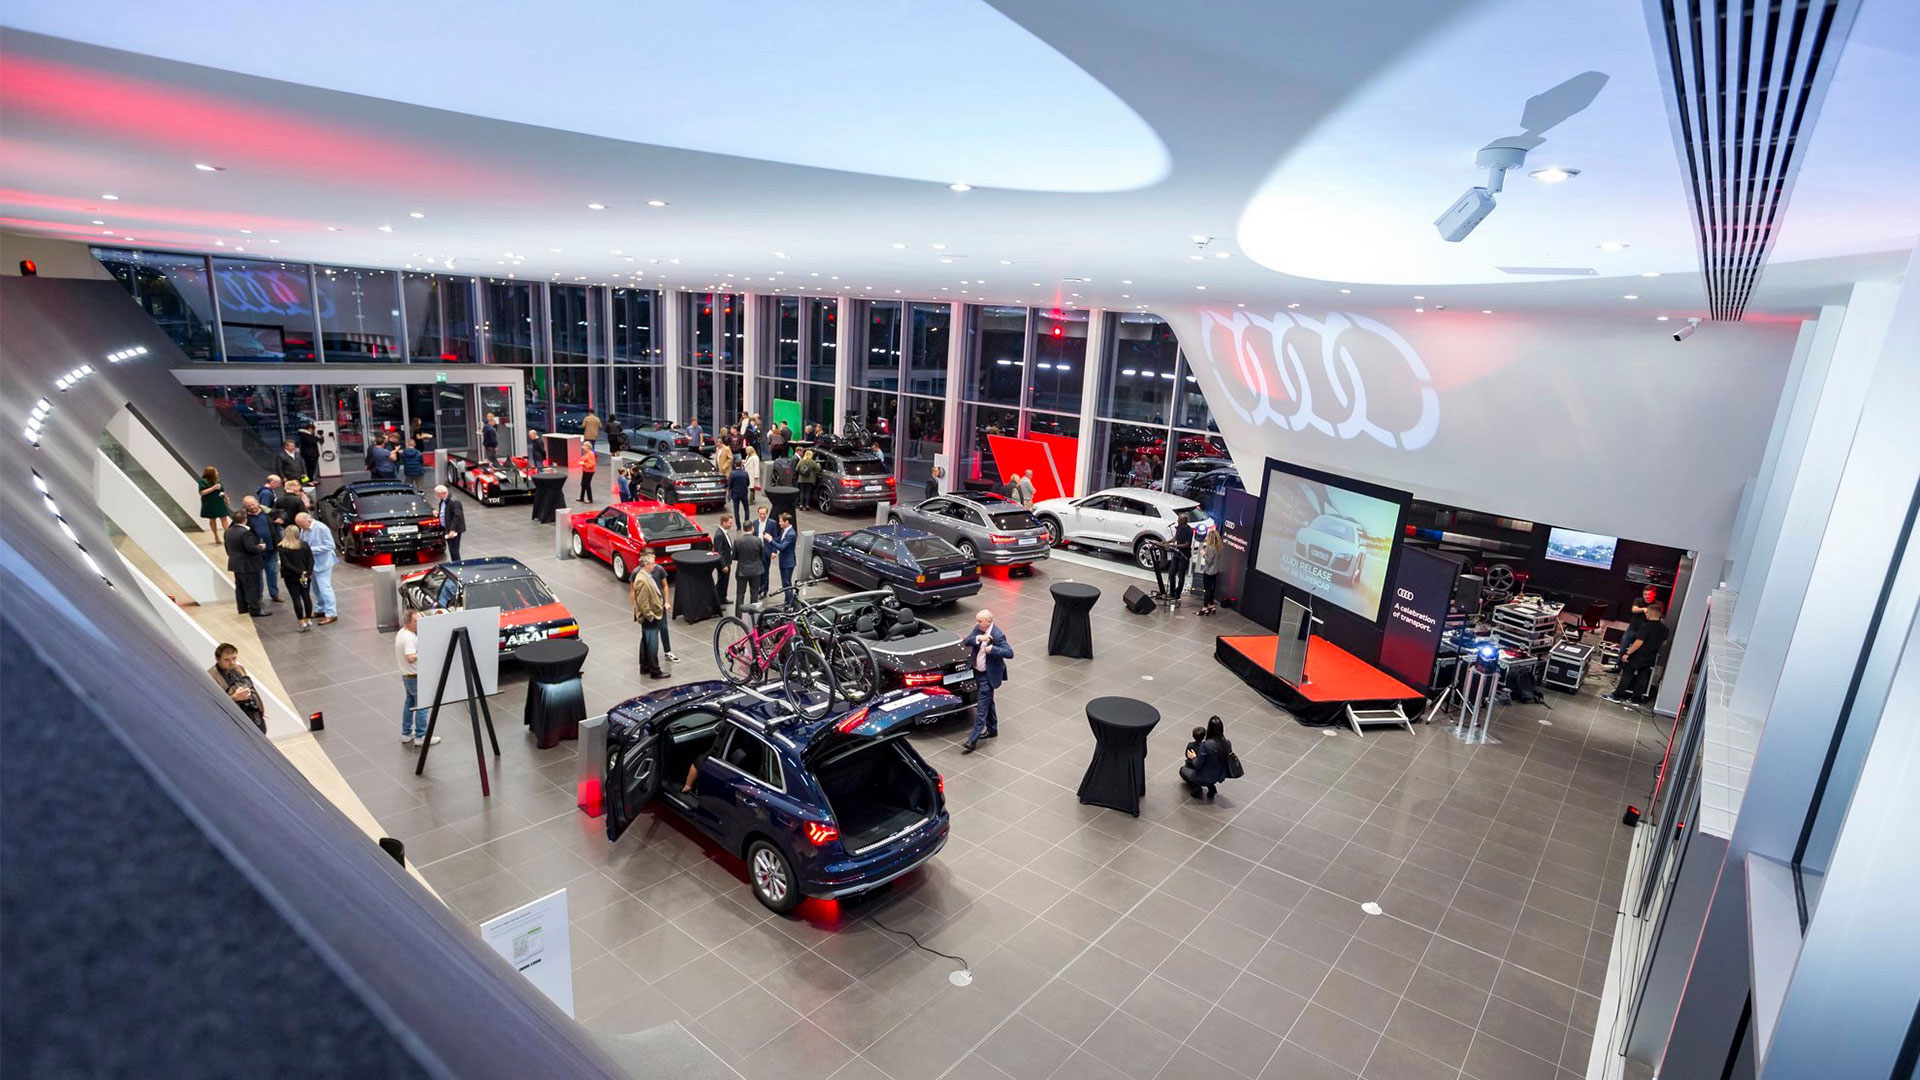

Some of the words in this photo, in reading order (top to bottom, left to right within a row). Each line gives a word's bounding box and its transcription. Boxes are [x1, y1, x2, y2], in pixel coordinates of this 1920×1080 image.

[1281, 553, 1299, 568] AUDI
[1300, 562, 1332, 581] RELEASE
[1299, 571, 1330, 591] SUPERCAR
[1400, 606, 1435, 624] celebration
[1400, 614, 1432, 632] transport.
[505, 630, 548, 645] AKAI
